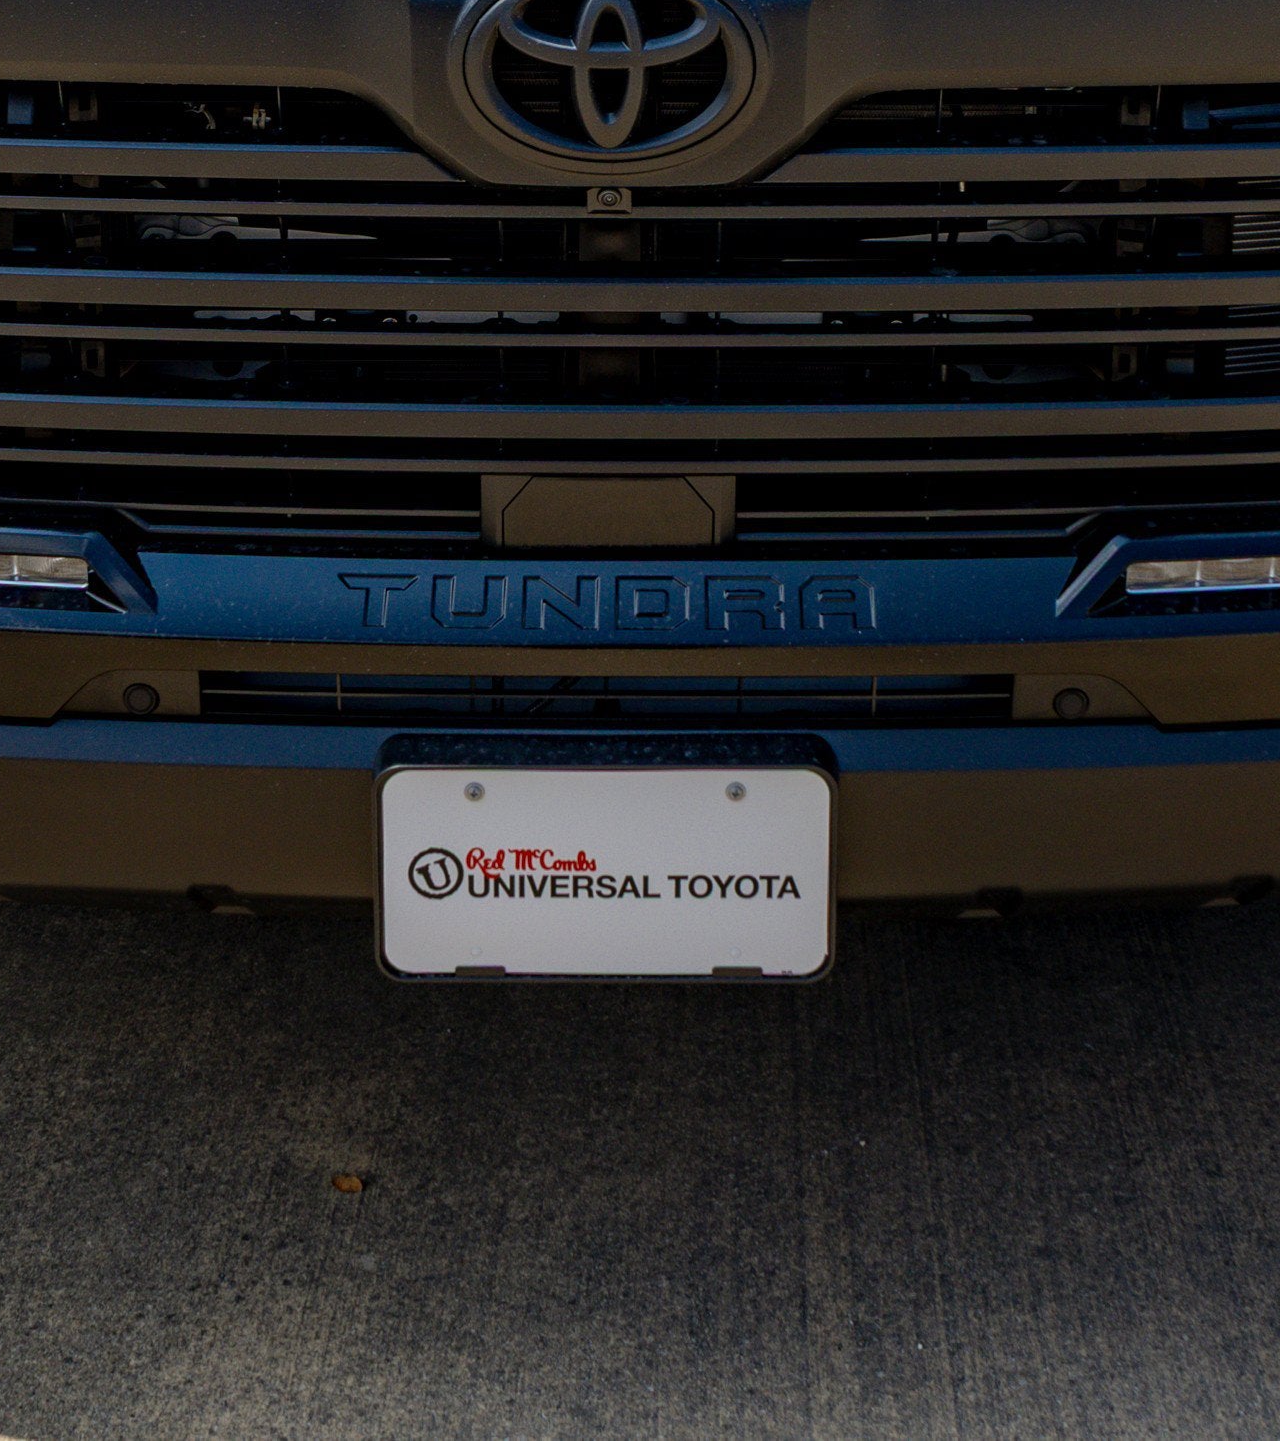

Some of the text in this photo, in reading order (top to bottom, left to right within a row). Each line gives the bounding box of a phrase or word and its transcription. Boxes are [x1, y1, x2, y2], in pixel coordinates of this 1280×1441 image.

[336, 572, 878, 631] TUNDRA
[466, 847, 597, 880] Red McCombs
[467, 874, 802, 900] UNIVERSAL TOYOTA
